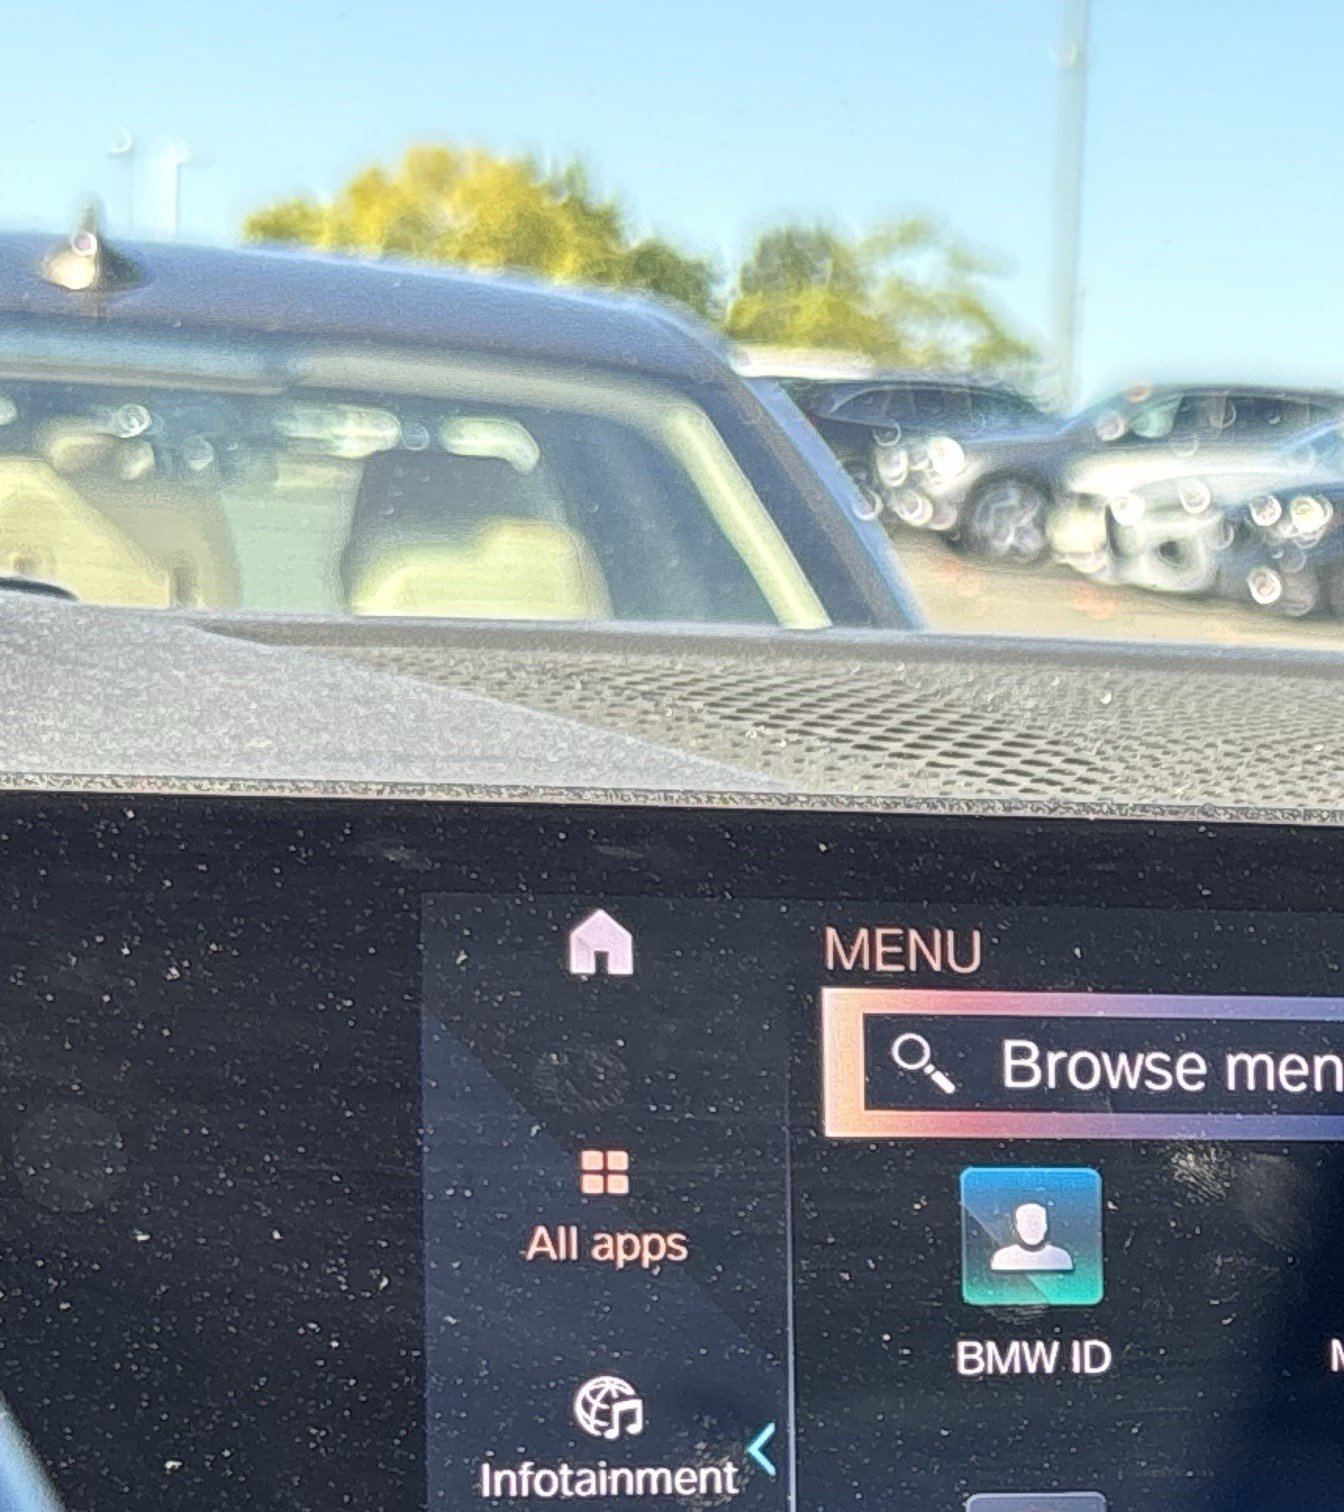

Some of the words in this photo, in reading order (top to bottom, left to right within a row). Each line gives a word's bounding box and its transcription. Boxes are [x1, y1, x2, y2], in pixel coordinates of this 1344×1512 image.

[824, 927, 982, 973] MENU
[1003, 1038, 1206, 1092] Browse
[527, 1226, 579, 1261] All
[591, 1230, 688, 1270] apps
[956, 1342, 1060, 1375] BMW
[1072, 1341, 1112, 1374] ID
[481, 1462, 739, 1498] Infotainment
